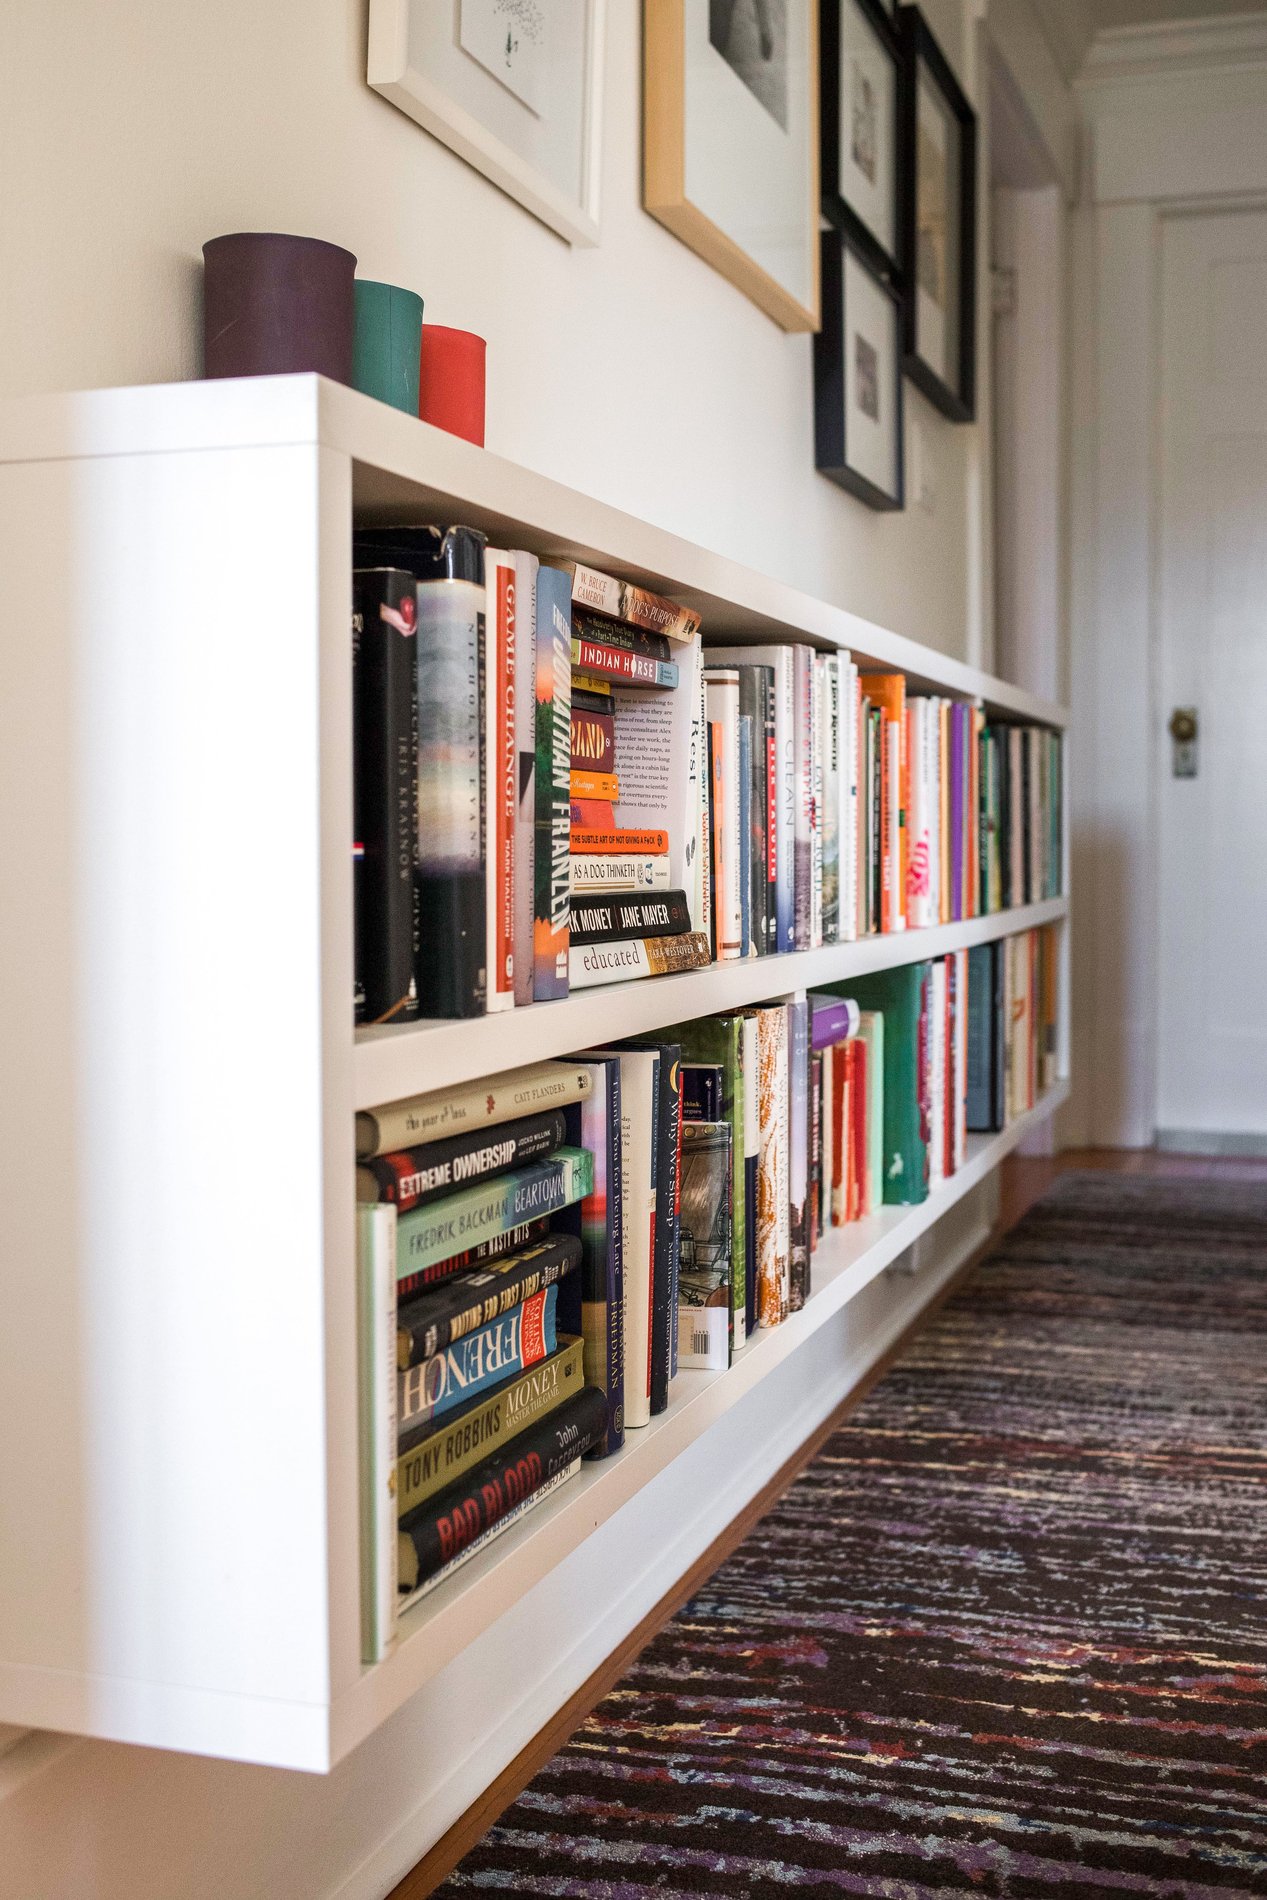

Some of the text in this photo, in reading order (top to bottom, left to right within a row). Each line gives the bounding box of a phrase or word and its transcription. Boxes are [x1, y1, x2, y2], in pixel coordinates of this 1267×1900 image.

[578, 587, 605, 605] CAMERON
[589, 575, 607, 592] BRUCE
[628, 597, 650, 617] DOG'S
[650, 607, 679, 628] PURPOSE
[584, 647, 620, 669] INDIAN
[505, 584, 515, 818] GAME CHANGE
[689, 720, 698, 783] Rest
[550, 635, 571, 936] JONATHAN FRANZEN
[572, 834, 580, 842] THE
[582, 835, 599, 844] SUBTLE
[600, 836, 608, 844] ART
[609, 836, 615, 844] OF
[616, 836, 624, 844] NOT
[626, 836, 639, 844] GIVING
[574, 864, 635, 878] AS A DOG THINKETH
[580, 904, 670, 932] MONEY JANE MAYER
[584, 943, 640, 971] educated
[666, 944, 694, 957] WESTOVER
[406, 1116, 420, 1131] the
[422, 1113, 438, 1129] year
[450, 1104, 467, 1121] less
[514, 1091, 530, 1104] CAIT
[532, 1083, 566, 1100] FLANDERS
[518, 1130, 550, 1148] JOCKO WILLINK
[526, 1146, 535, 1155] LEIF
[400, 1140, 516, 1200] EXTREME OWNERSHIP
[666, 1102, 679, 1227] Why We Sleep
[409, 1176, 565, 1256] FREDRIK BACKMAN BEARTOWN
[613, 1194, 621, 1238] Being
[477, 1224, 530, 1258] THE NASTY BITS
[450, 1304, 483, 1342] WAITING
[483, 1296, 498, 1322] FOR
[499, 1284, 520, 1314] FIRST
[521, 1272, 540, 1302] LIGHT
[534, 1298, 542, 1356] COLLINS
[402, 1314, 520, 1420] FRENCH
[505, 1361, 560, 1418] MONEY
[506, 1386, 560, 1428] MASTER THE GAME
[405, 1404, 500, 1494] TONY ROBBINS
[548, 1433, 591, 1475] Carreyrou
[555, 1424, 578, 1448] John
[536, 1477, 558, 1500] CHRISTIE
[558, 1466, 571, 1482] JACK
[436, 1452, 542, 1560] BAD BLOOD
[523, 1496, 535, 1510] THE
